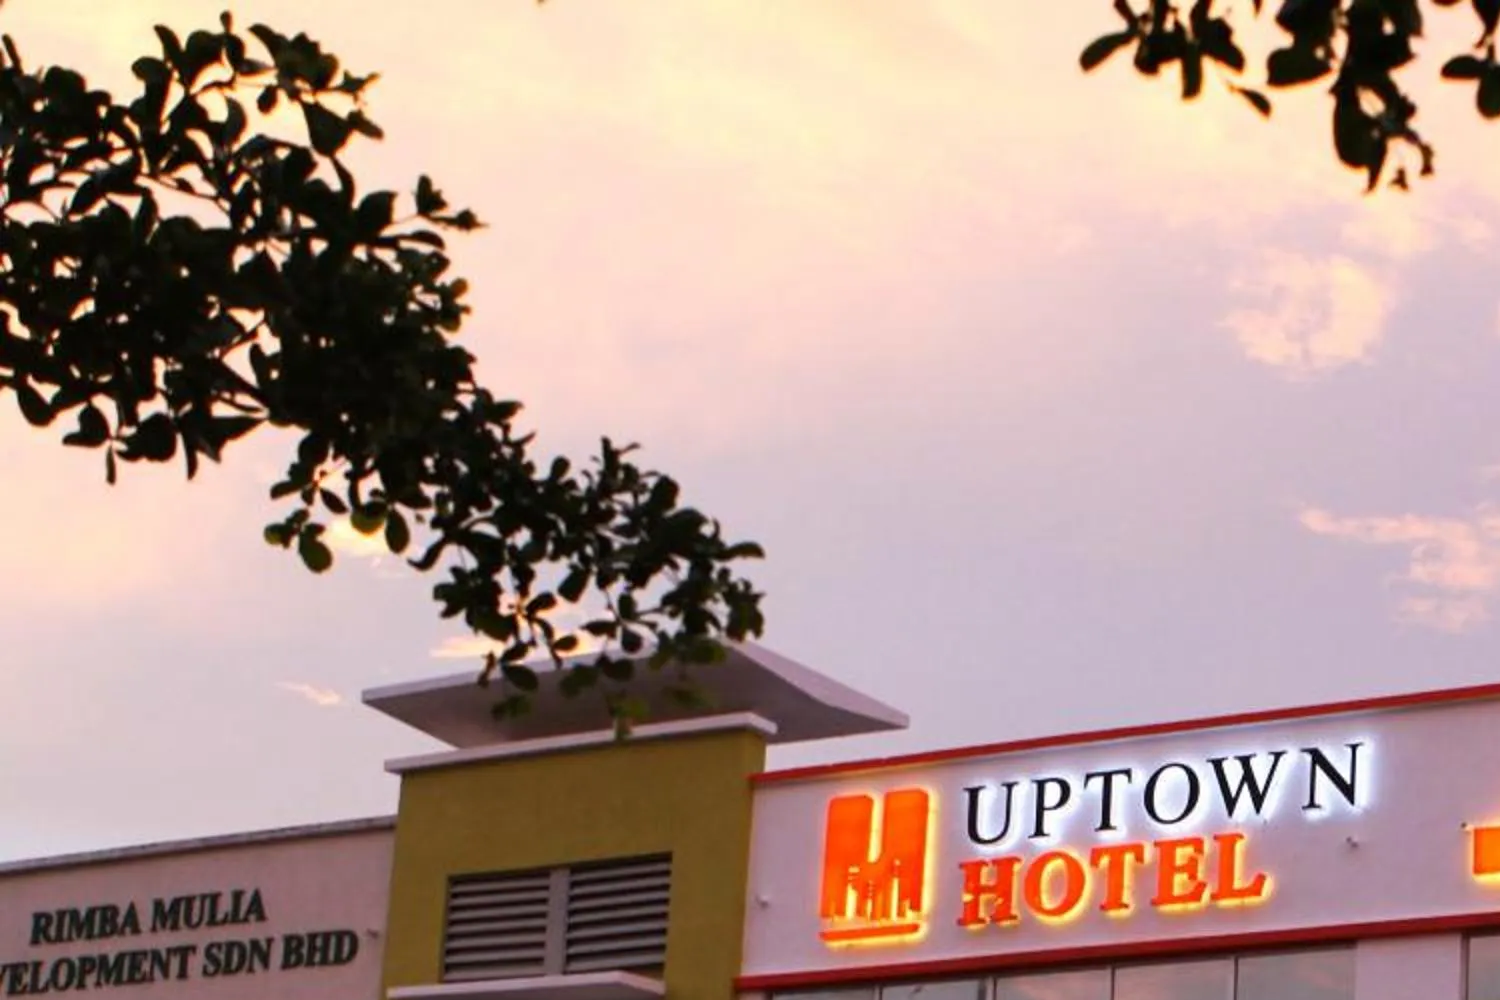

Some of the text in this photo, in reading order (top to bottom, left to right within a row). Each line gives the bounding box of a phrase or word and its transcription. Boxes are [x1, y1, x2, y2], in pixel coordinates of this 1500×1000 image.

[964, 743, 1363, 845] UPTOWN
[958, 833, 1267, 926] HOTEL
[30, 889, 267, 945] RIMBA MULIA
[202, 936, 274, 977] SDN
[281, 929, 359, 970] BHD
